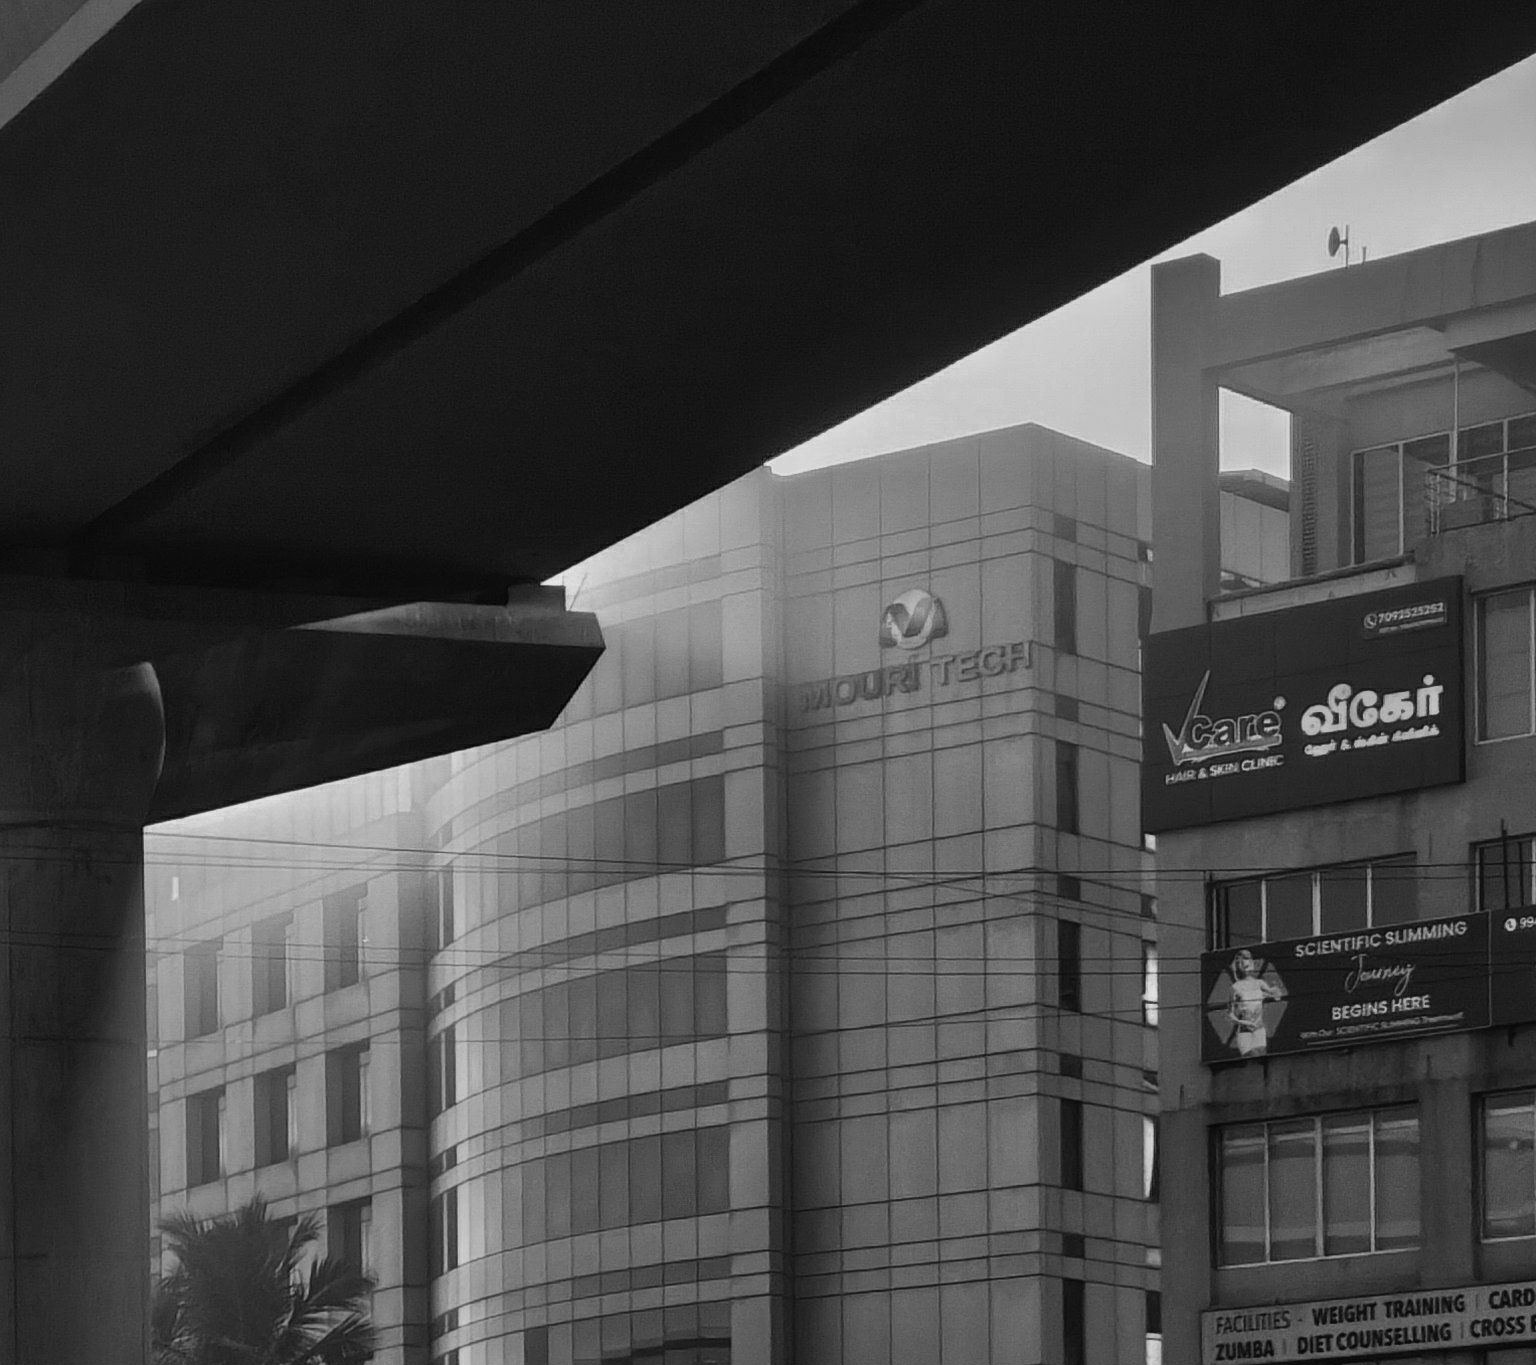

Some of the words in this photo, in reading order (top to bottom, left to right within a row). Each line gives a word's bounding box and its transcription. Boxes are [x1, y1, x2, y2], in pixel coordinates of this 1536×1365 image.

[931, 639, 1034, 687] TECH
[1301, 674, 1444, 736] வீகேர்
[1165, 769, 1197, 785] HAIR
[1209, 762, 1240, 778] SKIN
[1241, 754, 1285, 771] CLINIC
[1295, 933, 1381, 957] SCIENTIFIC
[1384, 920, 1468, 945] SLIMMING
[1331, 1001, 1388, 1021] BEGINS
[1390, 994, 1431, 1013] HERE
[1216, 1310, 1291, 1335] FACILITIES
[1312, 1302, 1377, 1326] WEIGHT
[1383, 1294, 1465, 1319] TRAINING
[1488, 1288, 1536, 1309] CARD
[1215, 1340, 1275, 1361] ZUMBA
[1297, 1334, 1333, 1355] DIET
[1336, 1323, 1452, 1350] COUNSELLING
[1470, 1315, 1526, 1337] CROSS
